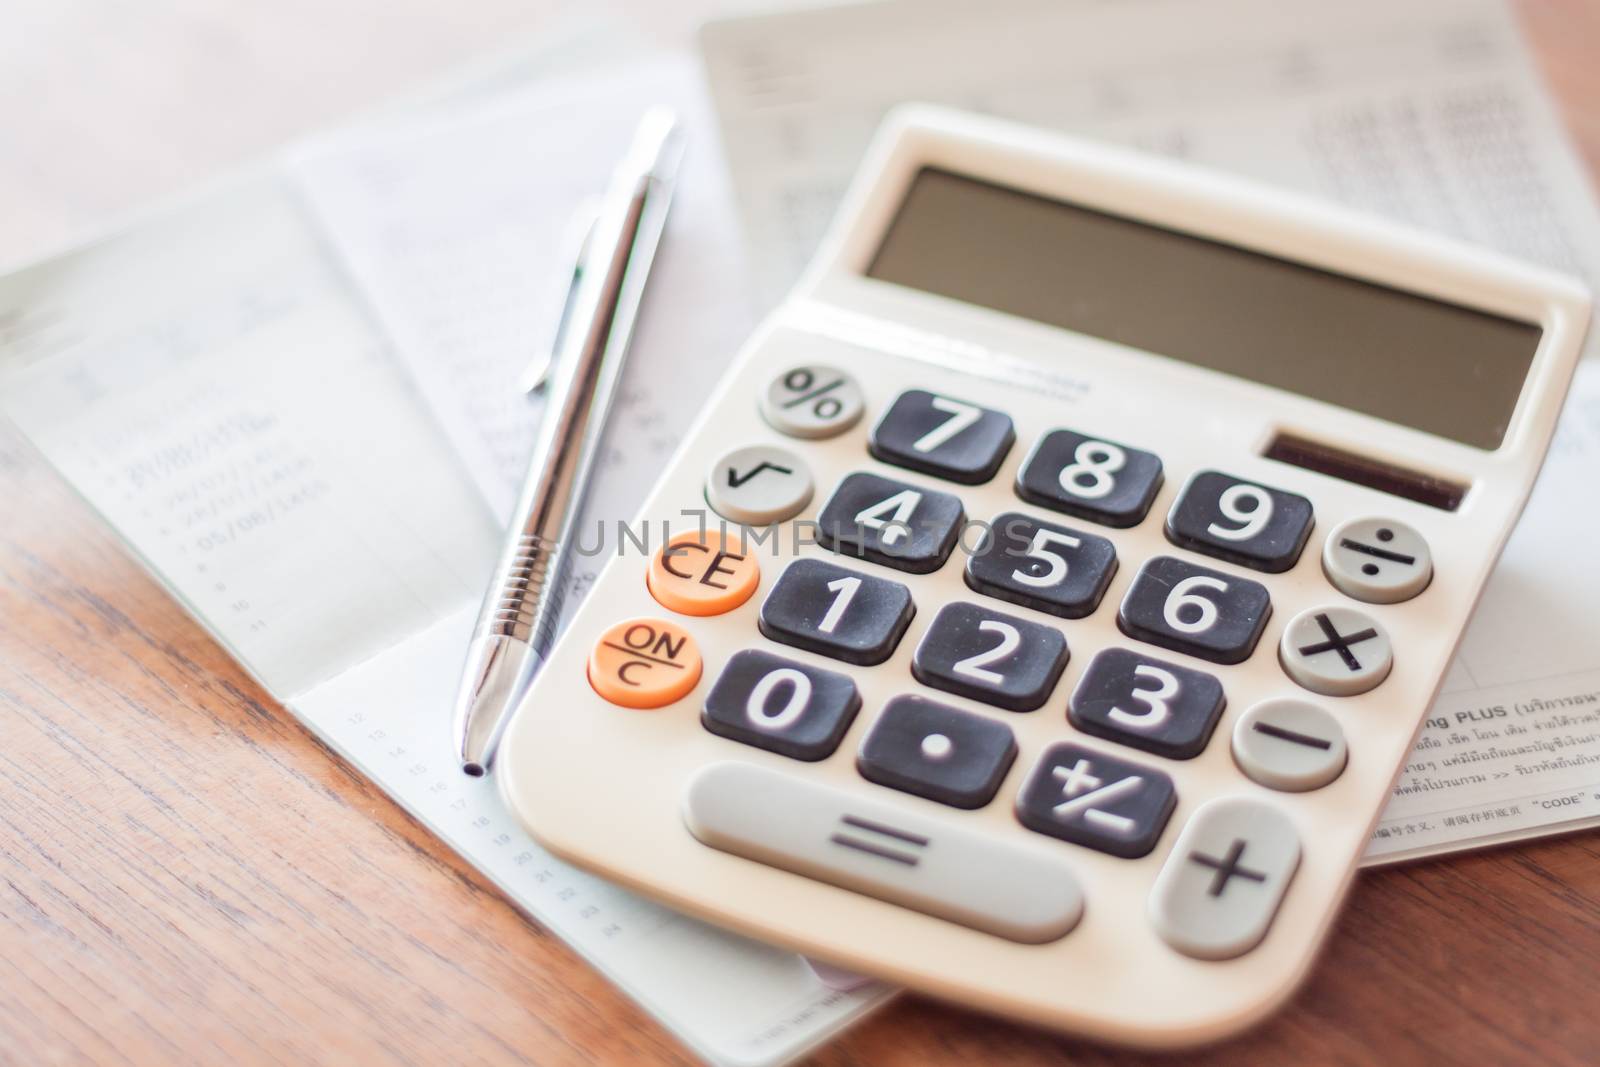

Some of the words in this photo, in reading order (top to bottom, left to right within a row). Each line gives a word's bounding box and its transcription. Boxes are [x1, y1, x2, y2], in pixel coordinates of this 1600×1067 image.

[911, 398, 983, 453] 7
[1058, 440, 1126, 499] 8
[854, 488, 922, 545] 4
[1207, 484, 1274, 541] 9
[660, 540, 745, 590] CE
[1011, 528, 1081, 588] 5
[817, 576, 863, 634] 1
[1163, 575, 1229, 634] 6
[623, 624, 688, 660] ON
[952, 620, 1021, 686] 2
[617, 660, 654, 687] C
[746, 668, 812, 730] 0
[1107, 664, 1180, 729] 3
[1425, 714, 1449, 730] ng
[1455, 706, 1508, 724] PLUS
[346, 711, 368, 727] 12
[367, 728, 388, 743] 13
[408, 761, 429, 777] 15
[429, 780, 448, 795] 16
[471, 814, 491, 830] 18
[491, 833, 512, 848] 19
[513, 850, 534, 866] 20
[534, 868, 554, 884] 21
